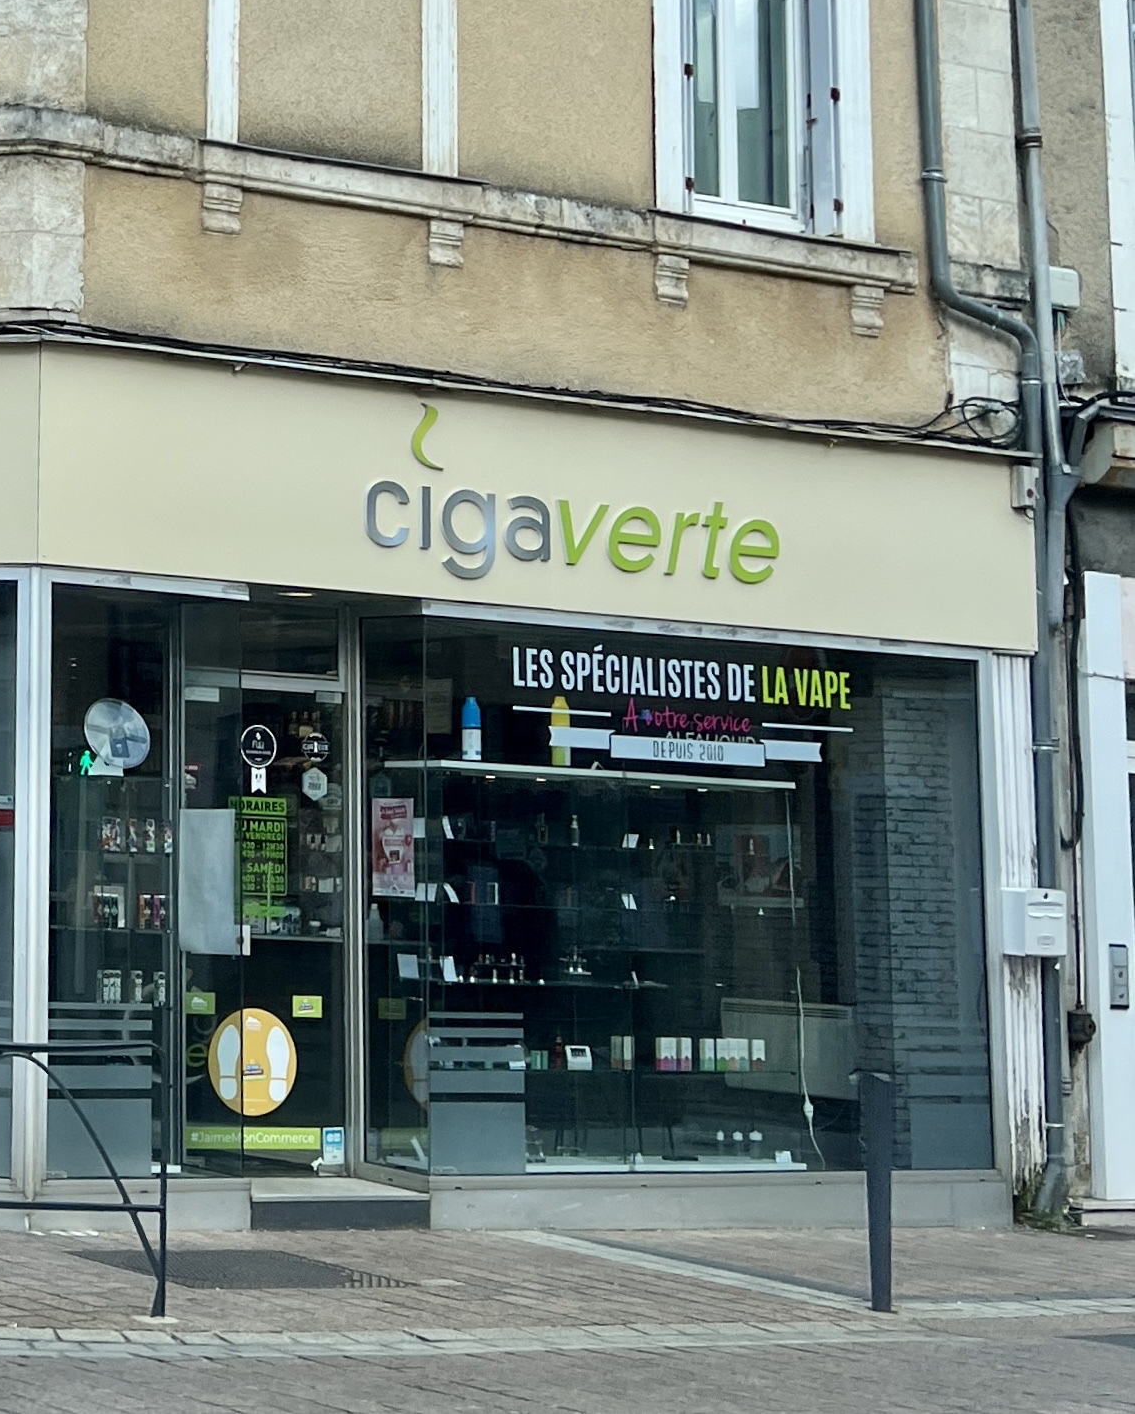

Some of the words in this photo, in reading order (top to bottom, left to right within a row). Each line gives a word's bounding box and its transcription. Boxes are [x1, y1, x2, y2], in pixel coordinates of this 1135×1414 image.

[366, 402, 780, 585] cigaverte
[512, 646, 555, 689] LES
[560, 644, 722, 701] SPÉCIALISTES
[727, 663, 756, 703] DE
[762, 665, 790, 705] LA
[794, 668, 851, 710] VAPE
[623, 697, 639, 732] A
[641, 705, 689, 729] votre
[693, 709, 753, 732] service
[652, 740, 694, 760] DEPUIS
[699, 744, 724, 762] 2010
[230, 799, 285, 813] HORAIRES
[249, 820, 284, 834] MARDI
[247, 862, 284, 874] SAMEDI
